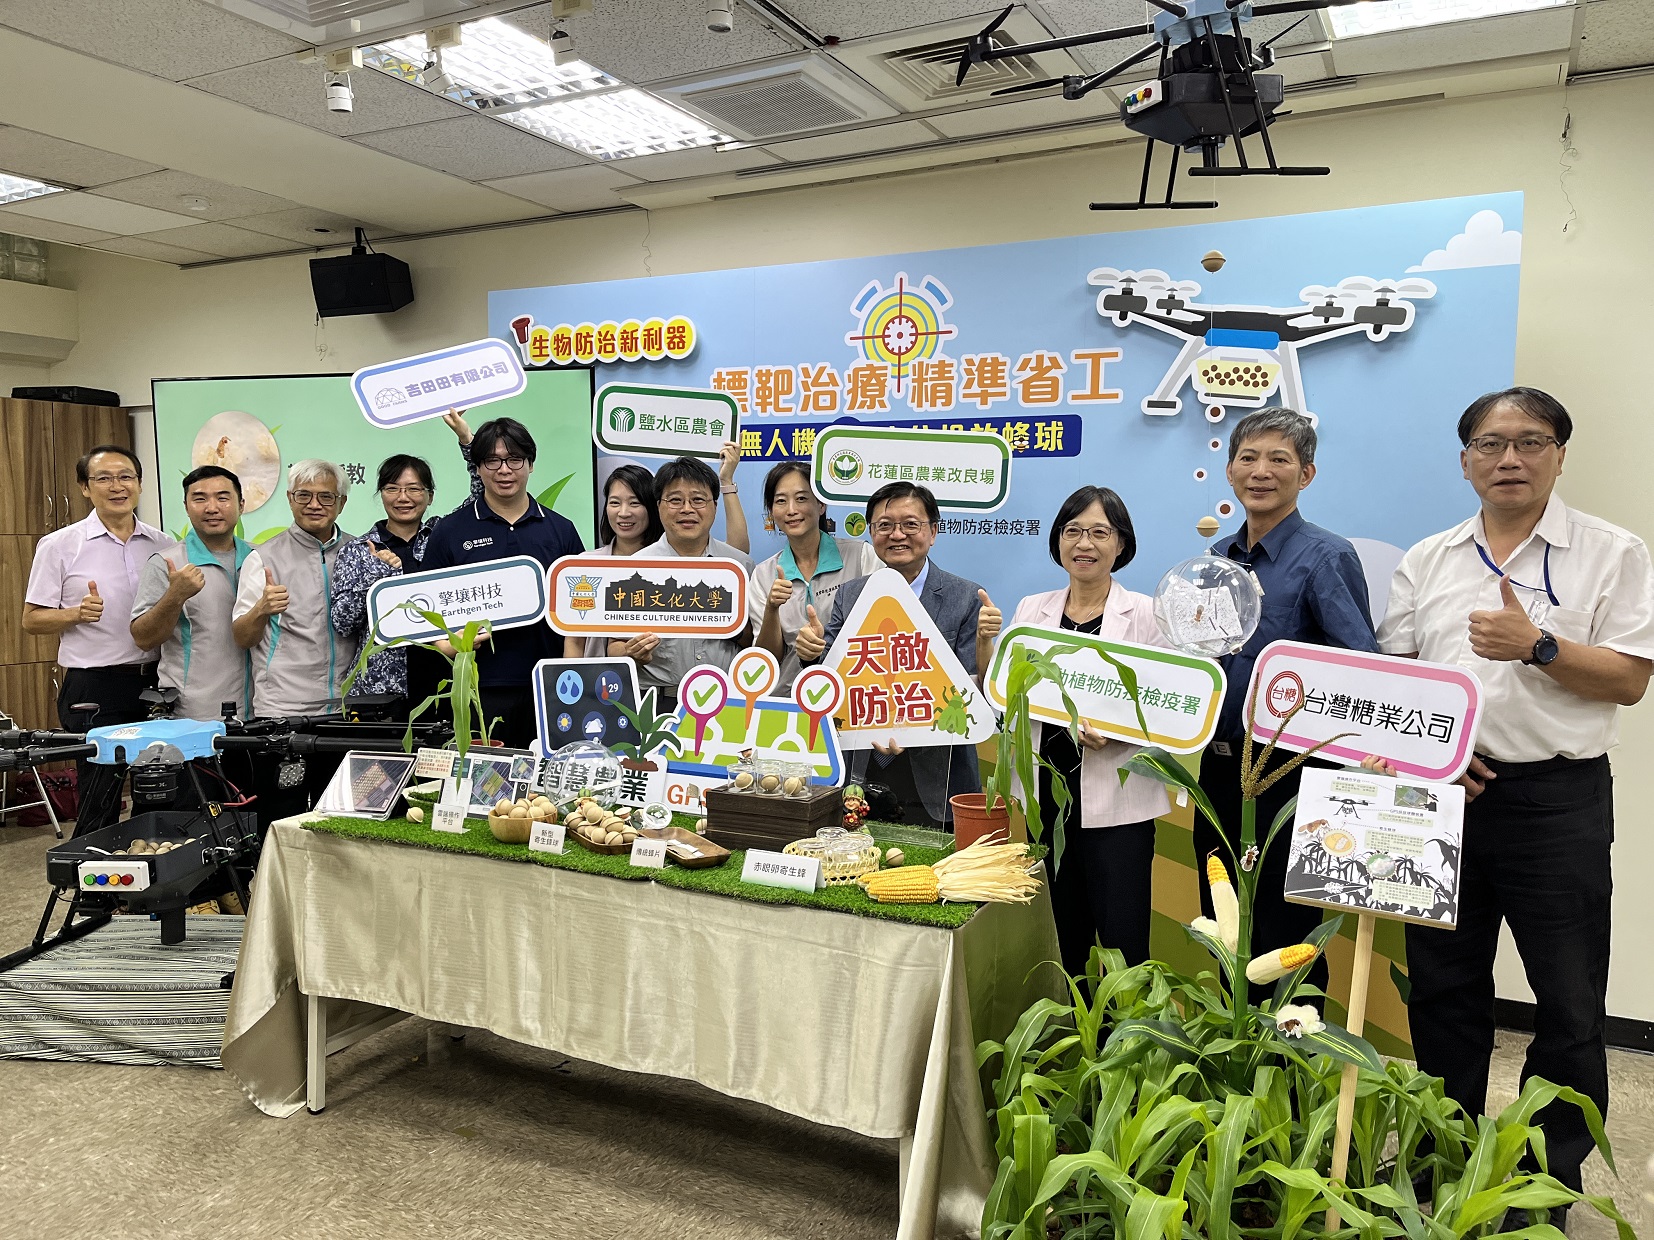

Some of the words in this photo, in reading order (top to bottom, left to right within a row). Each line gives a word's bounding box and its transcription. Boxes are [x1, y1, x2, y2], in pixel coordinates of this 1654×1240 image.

[532, 325, 687, 358] 生物防治新利器
[404, 361, 509, 398] 吉田田有限公司
[713, 364, 889, 413] 標靶治療
[911, 351, 1119, 408] 精準省工
[638, 413, 726, 437] 鹽水區農會
[867, 463, 996, 485] 花蓮區農業改良場
[438, 582, 503, 606] 擎壤科技
[612, 587, 723, 609] 中國文化大學
[441, 606, 482, 617] Earthgen
[482, 600, 504, 611] Tech
[604, 613, 641, 621] CHINESE
[642, 614, 681, 622] CULTURE
[846, 631, 932, 676] 天敵
[608, 683, 619, 693] 29
[1272, 685, 1297, 703] 台糖
[849, 682, 934, 726] 防治
[1303, 688, 1455, 744] 台灣糖業公司
[753, 861, 807, 878] 赤眼卵寄生蜂
